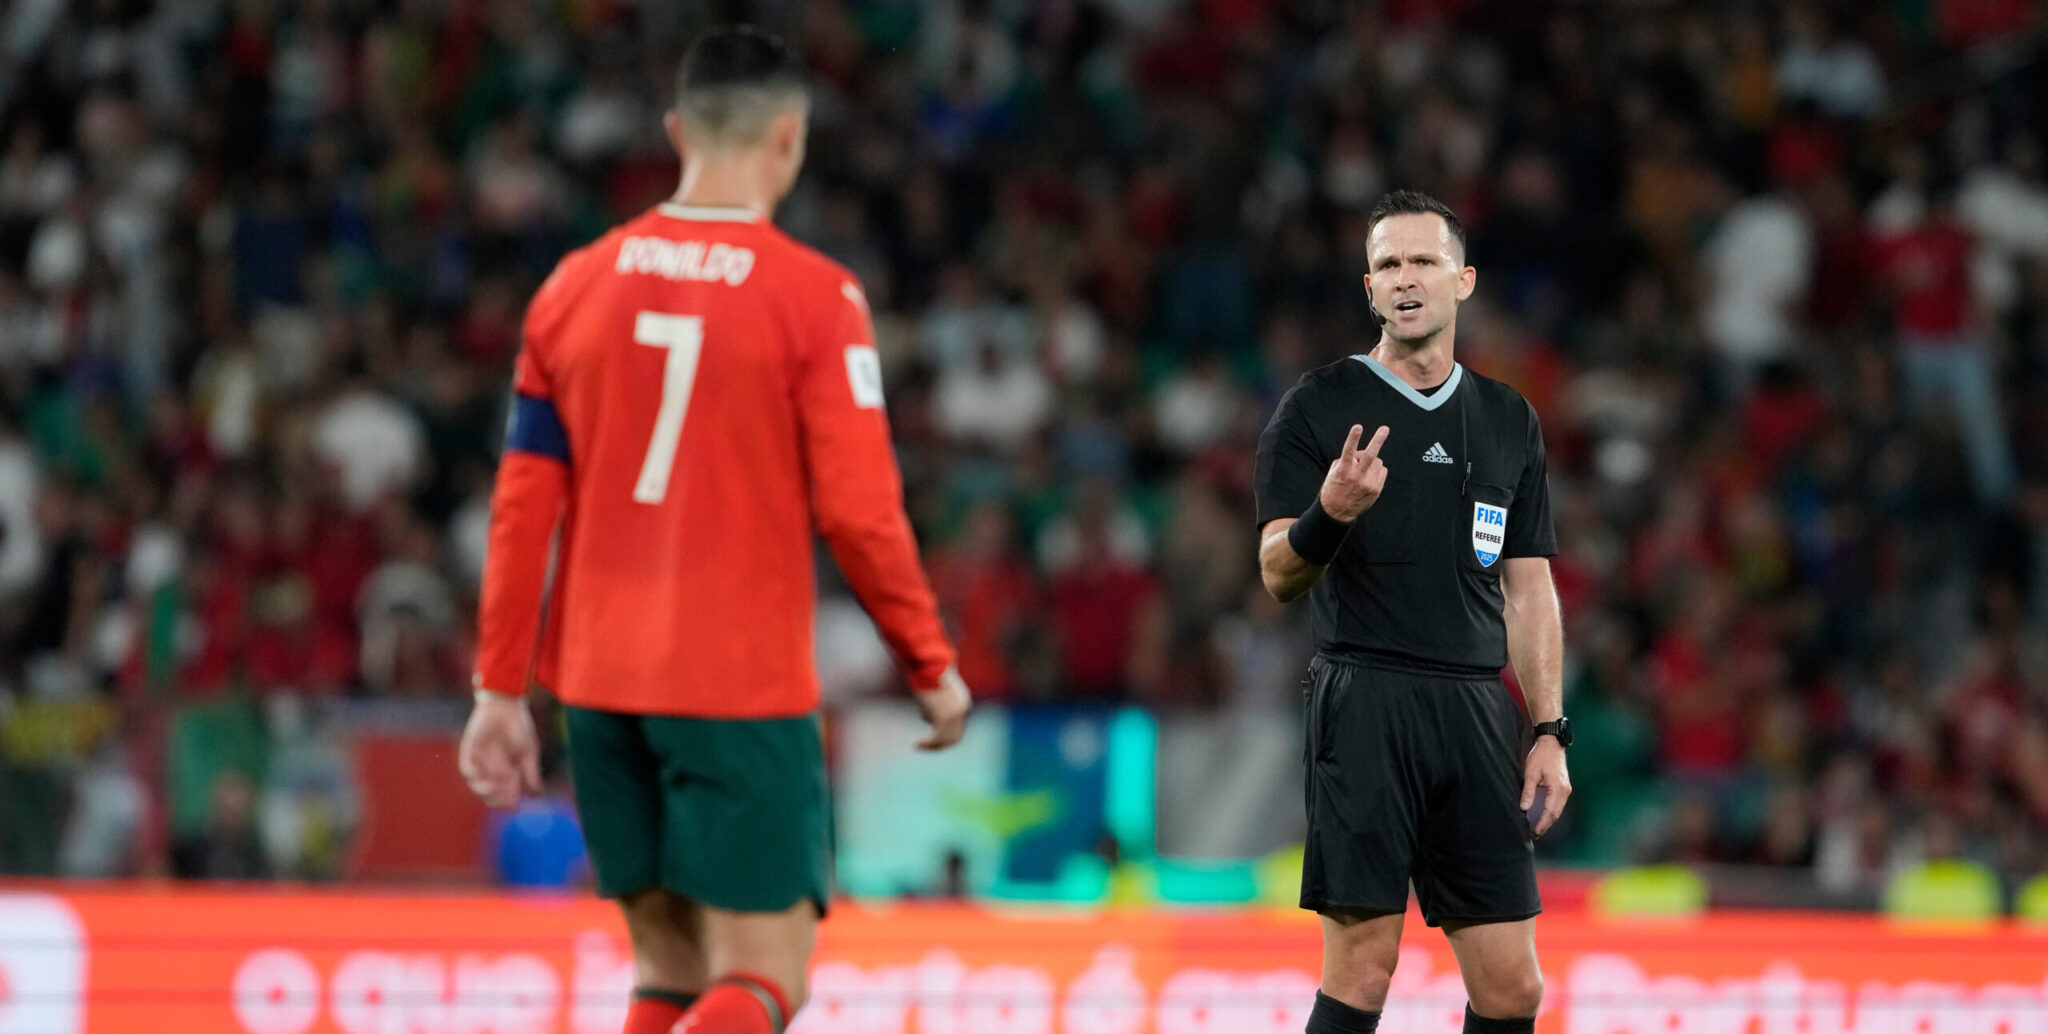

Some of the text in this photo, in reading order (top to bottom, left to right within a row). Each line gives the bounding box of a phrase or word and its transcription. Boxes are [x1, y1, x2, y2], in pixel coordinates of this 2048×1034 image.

[615, 235, 756, 287] RONALDO
[633, 310, 704, 504] 7
[1422, 454, 1454, 464] adidas
[1476, 506, 1503, 526] FIFA
[1475, 531, 1502, 544] REFEREE
[1480, 552, 1494, 561] 2025
